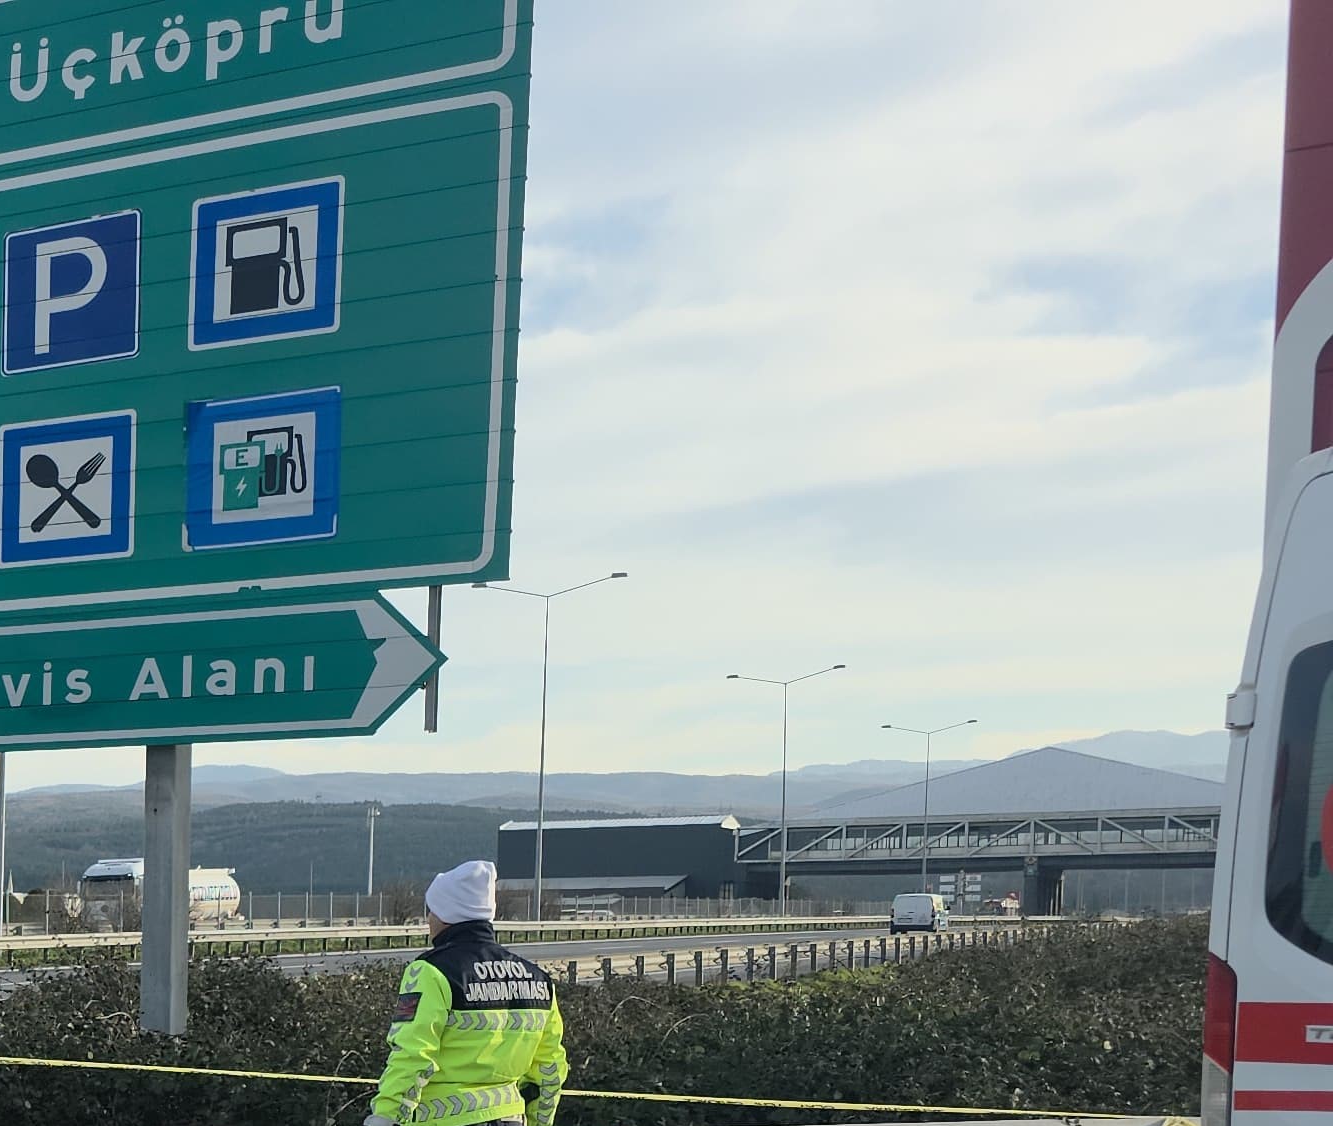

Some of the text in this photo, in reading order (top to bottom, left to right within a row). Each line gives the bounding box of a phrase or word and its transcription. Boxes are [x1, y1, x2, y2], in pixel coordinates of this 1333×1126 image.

[34, 236, 108, 355] P
[236, 448, 249, 467] E
[130, 654, 315, 701] Alanı
[473, 960, 533, 979] OTOYOL
[465, 980, 551, 1002] JANDARMASI
